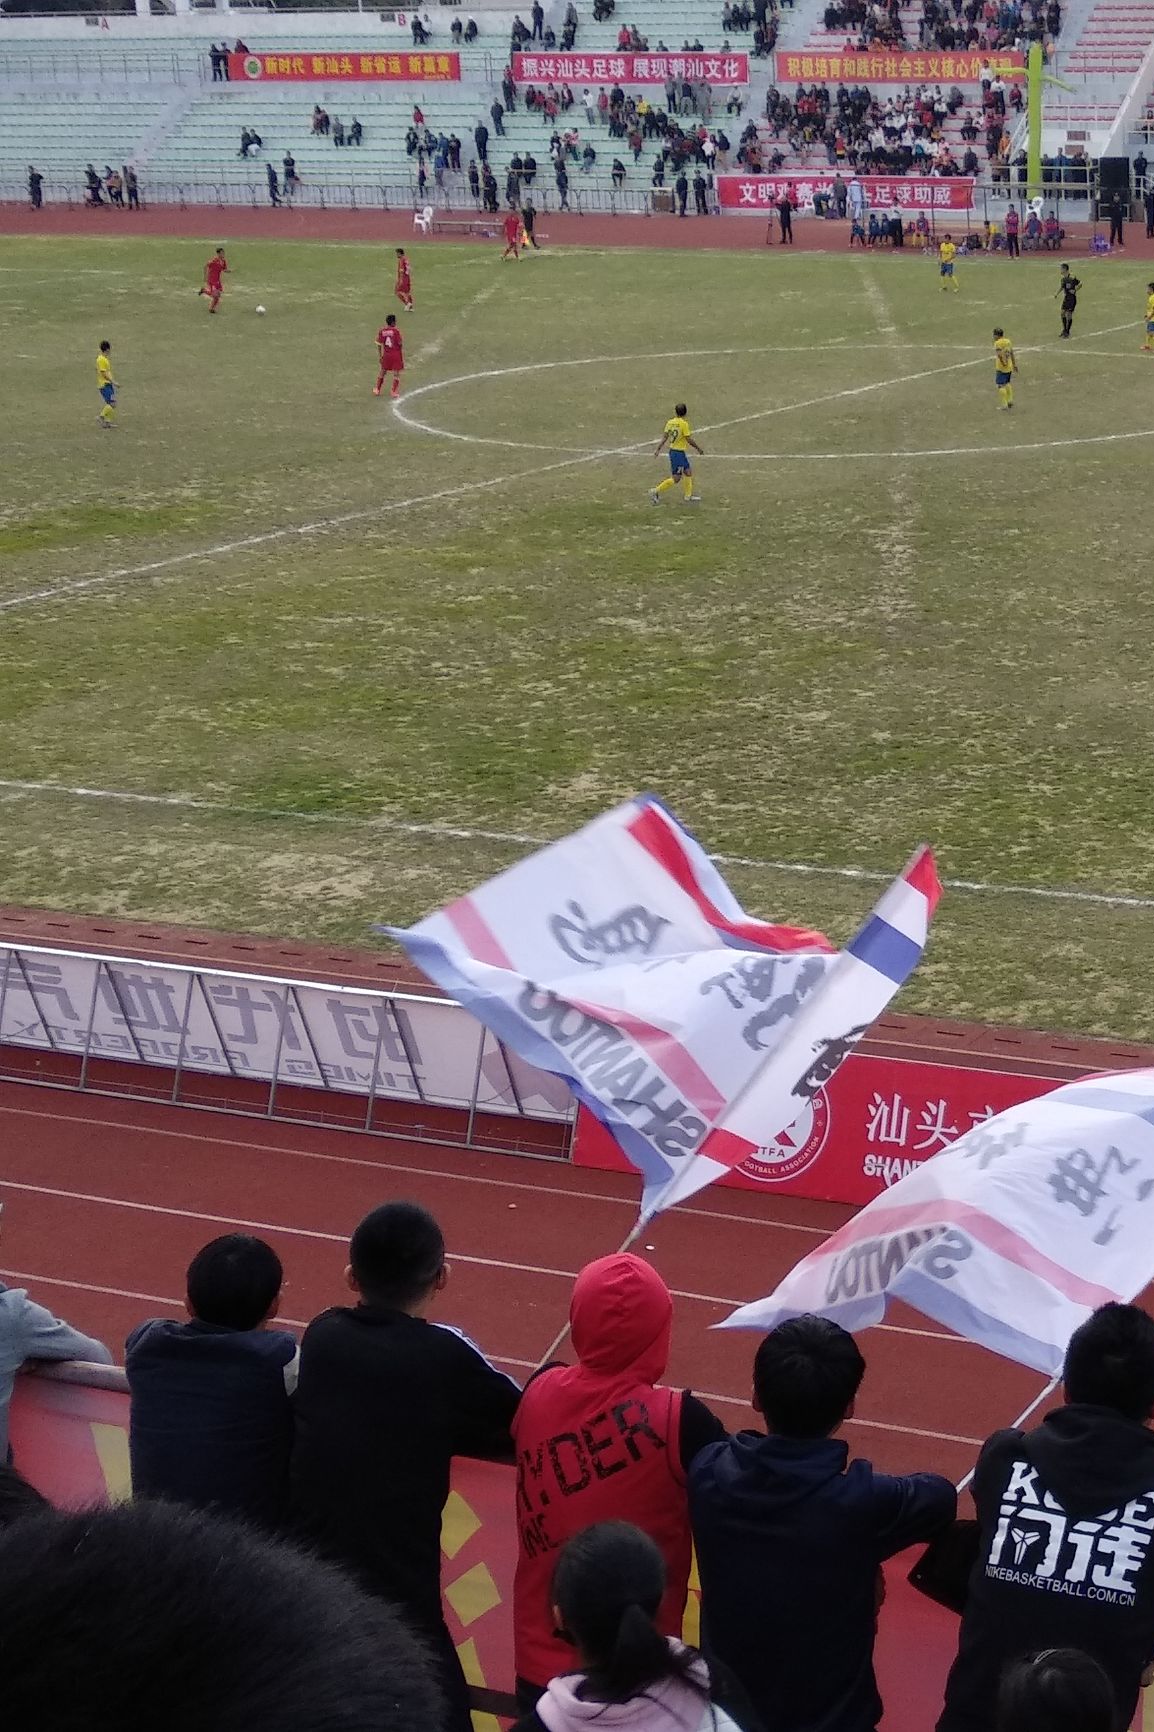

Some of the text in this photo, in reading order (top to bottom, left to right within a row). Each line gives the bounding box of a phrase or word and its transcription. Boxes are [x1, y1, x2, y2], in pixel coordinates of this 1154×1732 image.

[521, 58, 625, 79] 振兴汕头足球
[385, 337, 392, 348] 4
[862, 1153, 925, 1188] SHAN
[988, 1503, 1152, 1594] 门徒
[984, 1563, 1136, 1607] NIKEBASKETBALL.COM.CN
